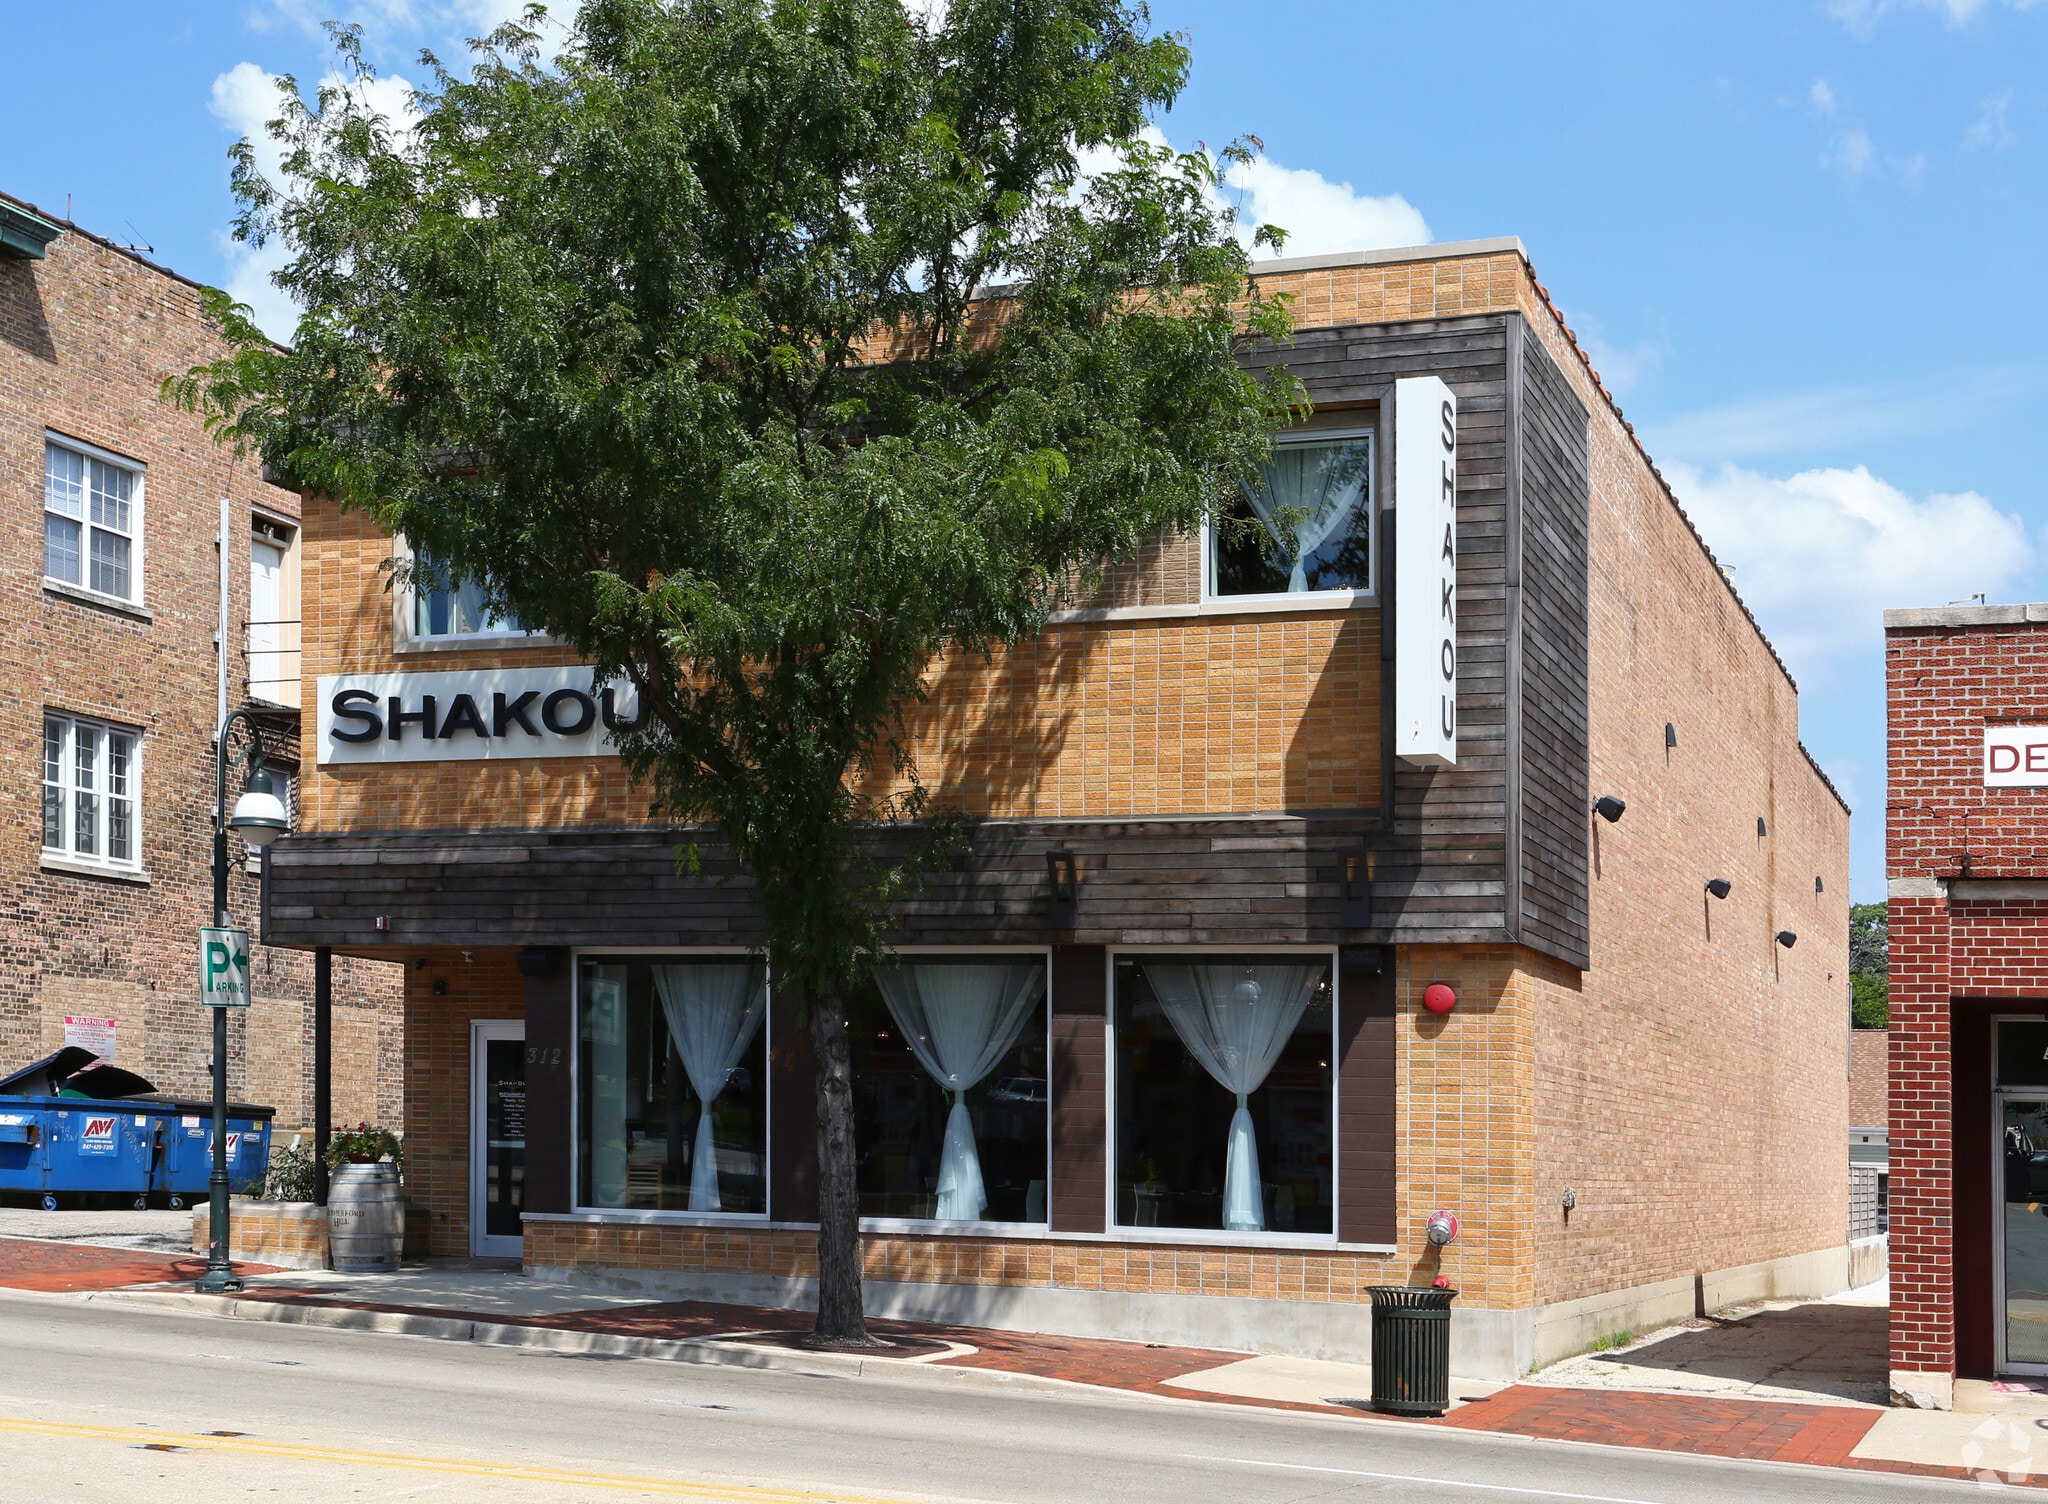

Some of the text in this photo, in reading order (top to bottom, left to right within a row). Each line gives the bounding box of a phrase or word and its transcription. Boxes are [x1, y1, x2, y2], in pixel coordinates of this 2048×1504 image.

[1441, 400, 1455, 742] SHAKOU
[330, 688, 648, 743] SHAKOU
[1990, 744, 2048, 773] DE
[72, 1017, 110, 1026] WARNING
[527, 1048, 561, 1064] 312
